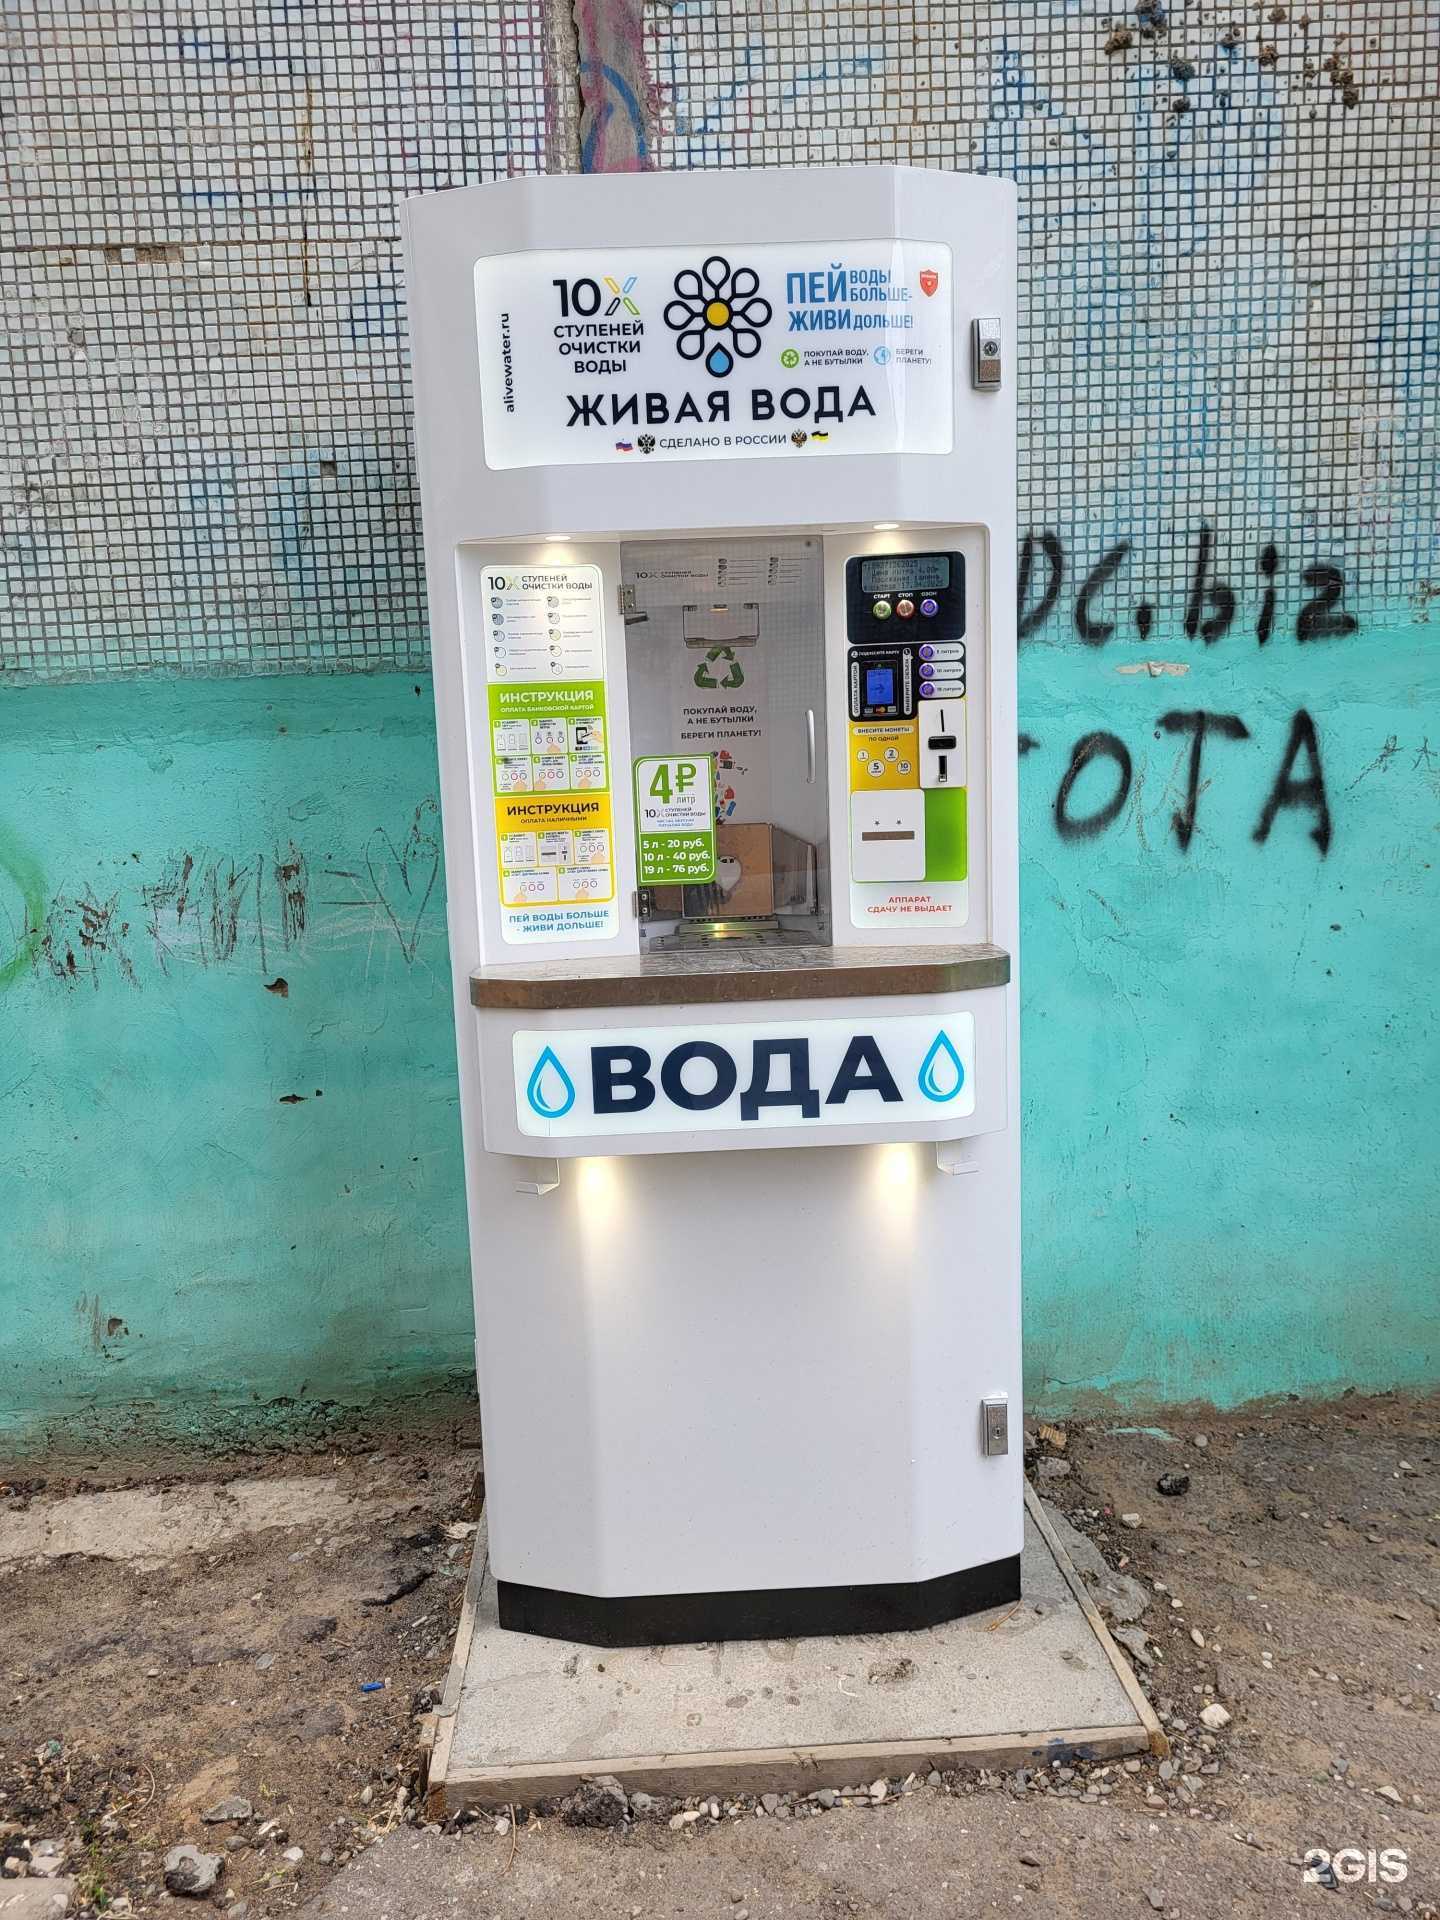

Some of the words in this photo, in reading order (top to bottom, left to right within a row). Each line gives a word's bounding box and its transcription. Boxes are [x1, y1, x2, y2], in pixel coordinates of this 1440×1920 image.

[850, 269, 892, 284] ВОДЫ
[786, 263, 847, 304] ПЕЙ
[788, 309, 850, 332] ЖИВИ
[853, 314, 913, 331] ДОЛЬШЕ!
[553, 320, 644, 338] СТУПЕНЕЙ
[558, 340, 641, 355] ОЧИСТКИ
[804, 348, 843, 357] ПОКУПАЙ
[845, 349, 869, 357] ВОДУ,
[896, 348, 924, 356] БЕРЕГИ
[501, 313, 515, 412] alivewater.ru
[574, 360, 627, 375] ВОДЫ
[825, 358, 863, 366] БУТЫЛКИ
[566, 390, 730, 427] ЖИВАЯ
[752, 385, 876, 424] ВОДА
[659, 436, 721, 450] СДЕЛАНО
[724, 436, 732, 446] В
[735, 434, 787, 445] РОССИИ
[499, 690, 594, 703] ИНСТРУКЦИЯ
[527, 704, 569, 712] БАНКОВСКОЙ
[683, 705, 728, 715] ПОКУПАЙ
[729, 706, 757, 714] ВОДУ,
[710, 716, 754, 724] БУТЫЛКИ
[681, 731, 715, 740] БЕРЕГИ
[716, 729, 761, 738] ПЛАНЕТУ!
[676, 796, 696, 806] литр
[507, 802, 599, 816] ИНСТРУКЦИЯ
[643, 841, 649, 849] 5
[667, 840, 680, 848] 20
[683, 838, 705, 850] руб.
[643, 853, 654, 861] 10
[656, 853, 664, 861] л
[673, 851, 687, 860] 40
[689, 850, 711, 862] руб.
[644, 866, 655, 874] 19
[656, 866, 664, 874] л
[672, 864, 685, 873] 76
[688, 863, 710, 875] руб.
[509, 912, 530, 923] ПЕЙ
[532, 912, 564, 922] ВОДЫ
[566, 910, 609, 920] БОЛЬШЕ
[522, 924, 554, 933] ЖИВИ
[556, 920, 604, 931] ДОЛЬШЕ!
[591, 1035, 903, 1121] ВОДА
